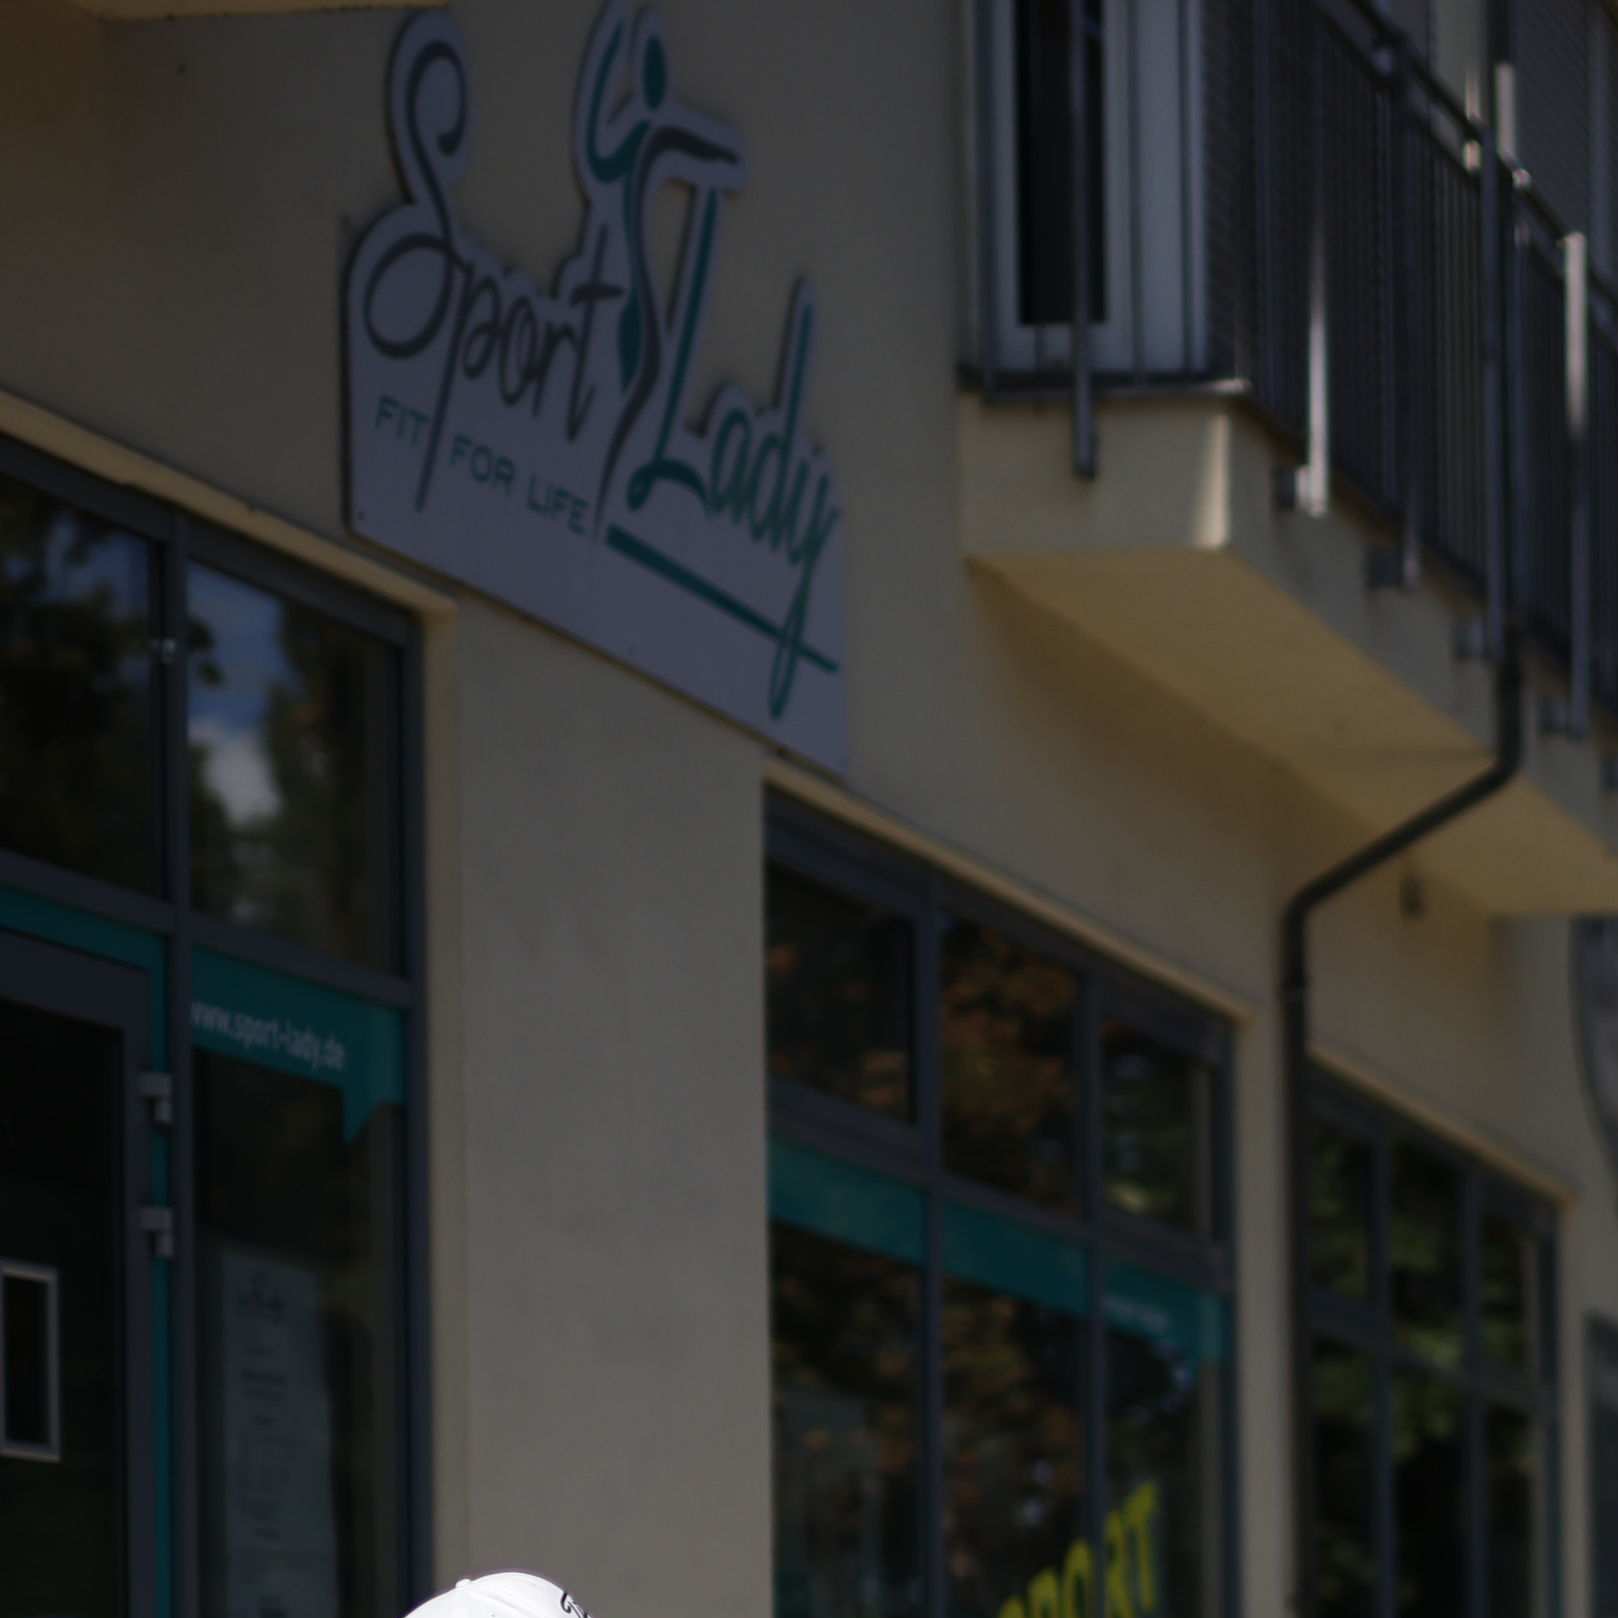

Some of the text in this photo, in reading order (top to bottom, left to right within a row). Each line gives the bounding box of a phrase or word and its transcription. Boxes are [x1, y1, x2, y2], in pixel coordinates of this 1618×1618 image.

[364, 40, 624, 512] Sport
[376, 395, 589, 536] FIT FOR LIFE
[627, 187, 842, 720] Lady
